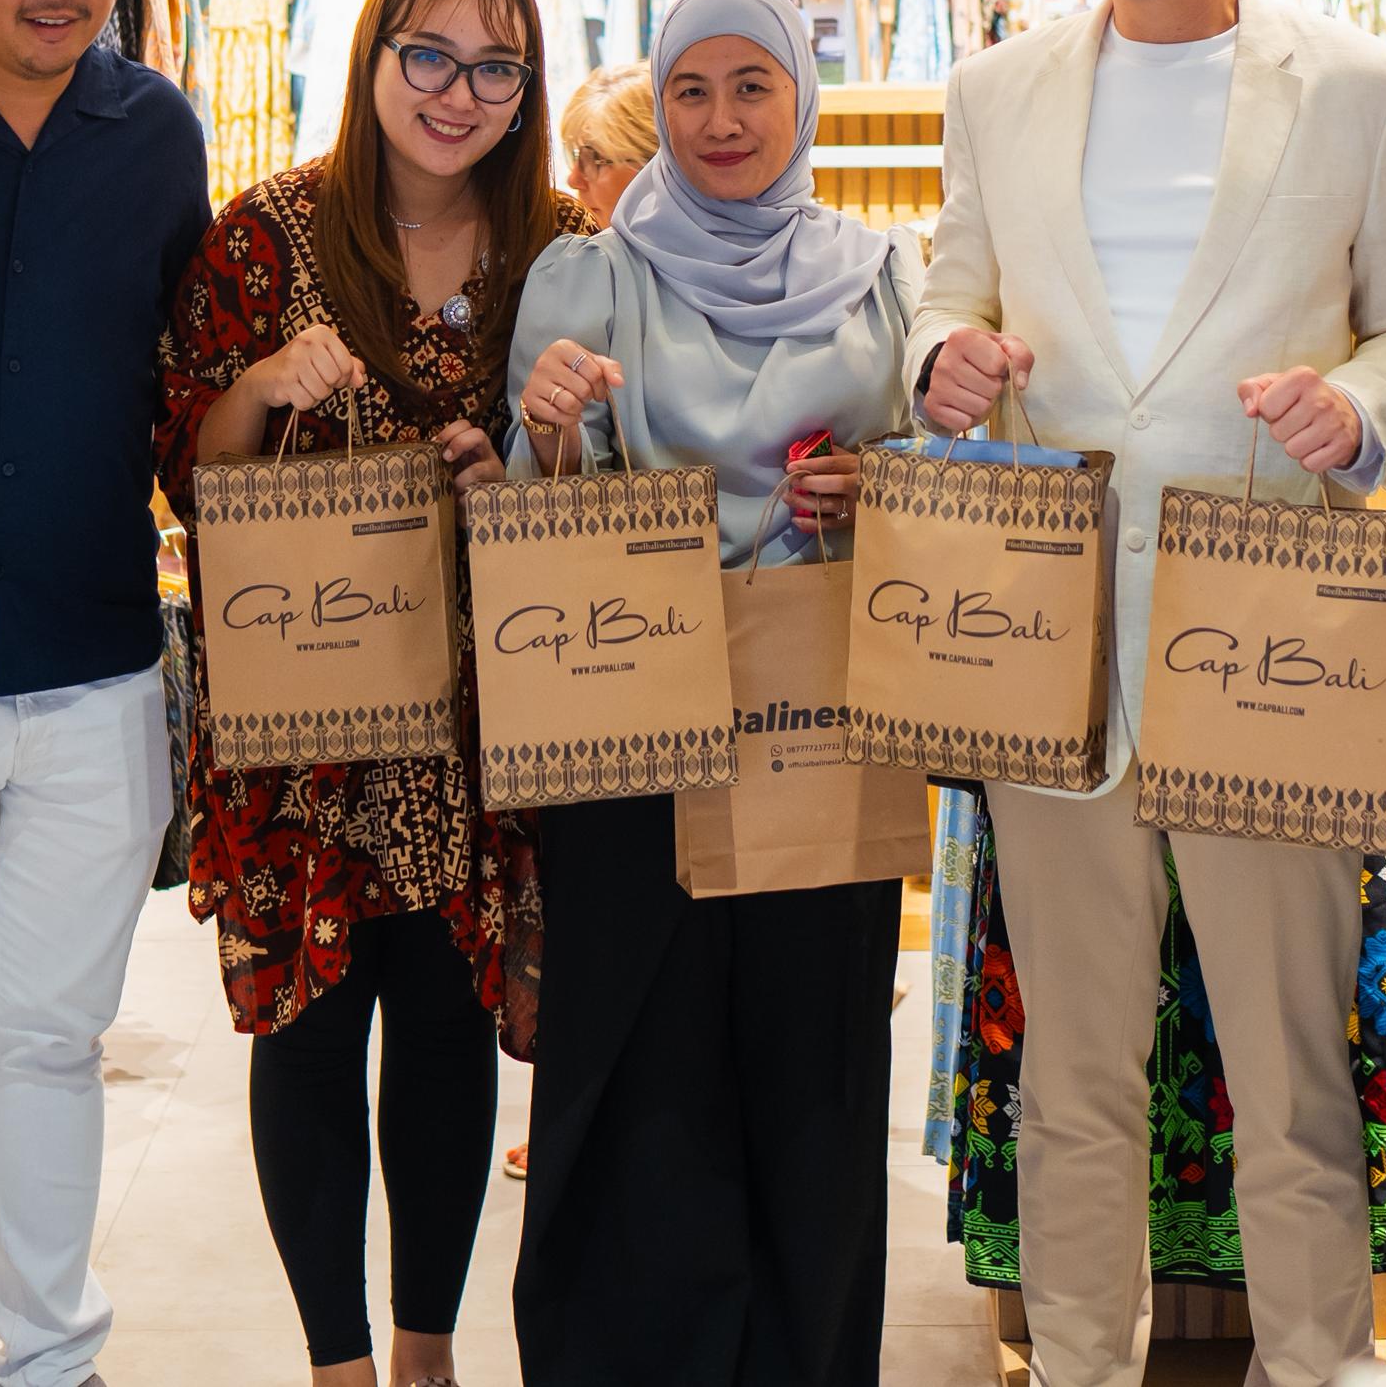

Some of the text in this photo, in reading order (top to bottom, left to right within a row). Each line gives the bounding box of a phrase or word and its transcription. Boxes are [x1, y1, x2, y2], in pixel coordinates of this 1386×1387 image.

[353, 517, 427, 533] #feelbaliwithcapbal
[627, 538, 702, 552] #feelbaliwithcapbal
[223, 577, 426, 641] Cap Bali
[868, 580, 1070, 645] Cap Bali
[494, 597, 702, 664] Cap Bali
[296, 640, 360, 652] WWW.CAPBALI.COM
[928, 651, 994, 668] WWW.CAPBALI.COM
[1165, 627, 1250, 693] Cap
[571, 662, 636, 676] WWW.CAPBALI.COM
[1236, 700, 1305, 717] WWW.CAPBALI.COM
